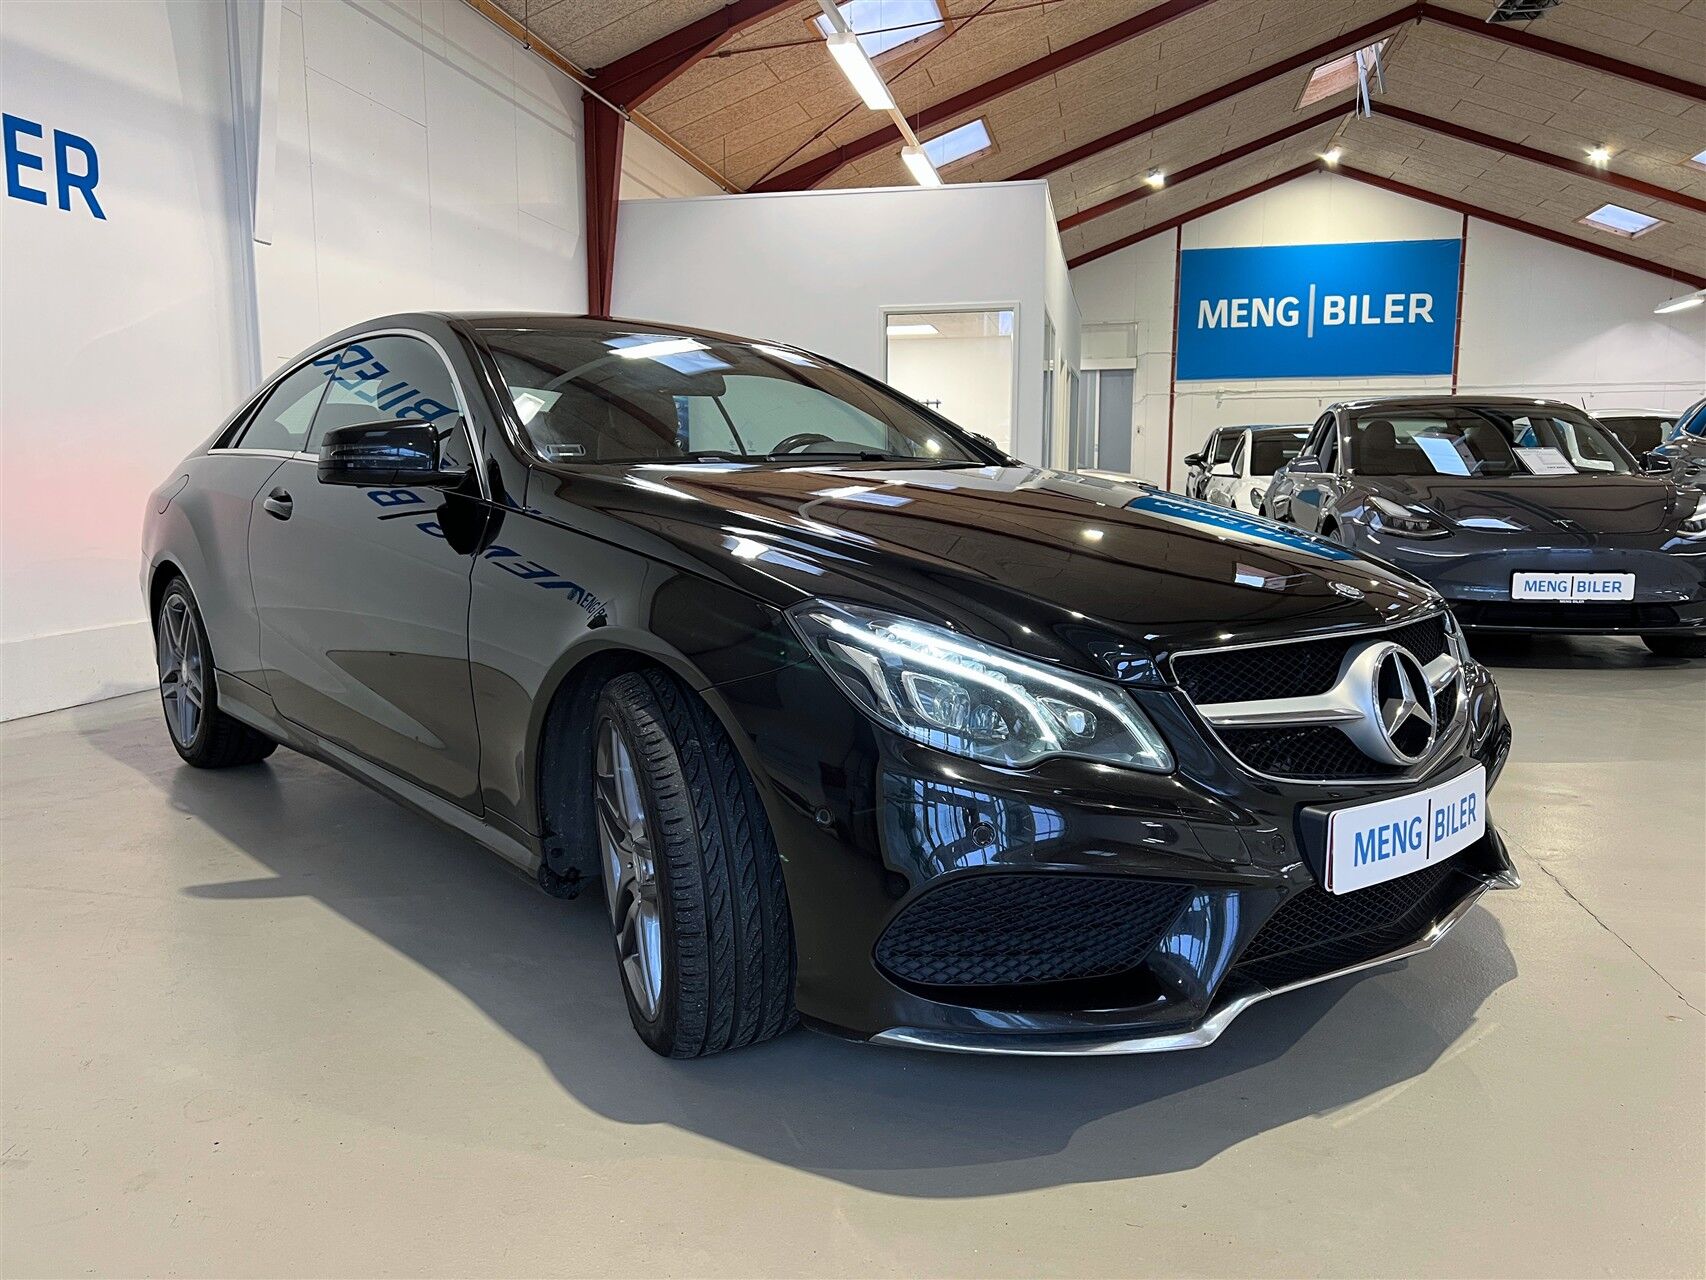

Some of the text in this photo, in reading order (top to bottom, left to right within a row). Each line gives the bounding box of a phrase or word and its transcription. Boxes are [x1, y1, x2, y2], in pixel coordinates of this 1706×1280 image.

[1197, 292, 1434, 330] MENG BILER
[1524, 580, 1622, 593] MENG BILER
[1354, 792, 1477, 867] MENG BILER
